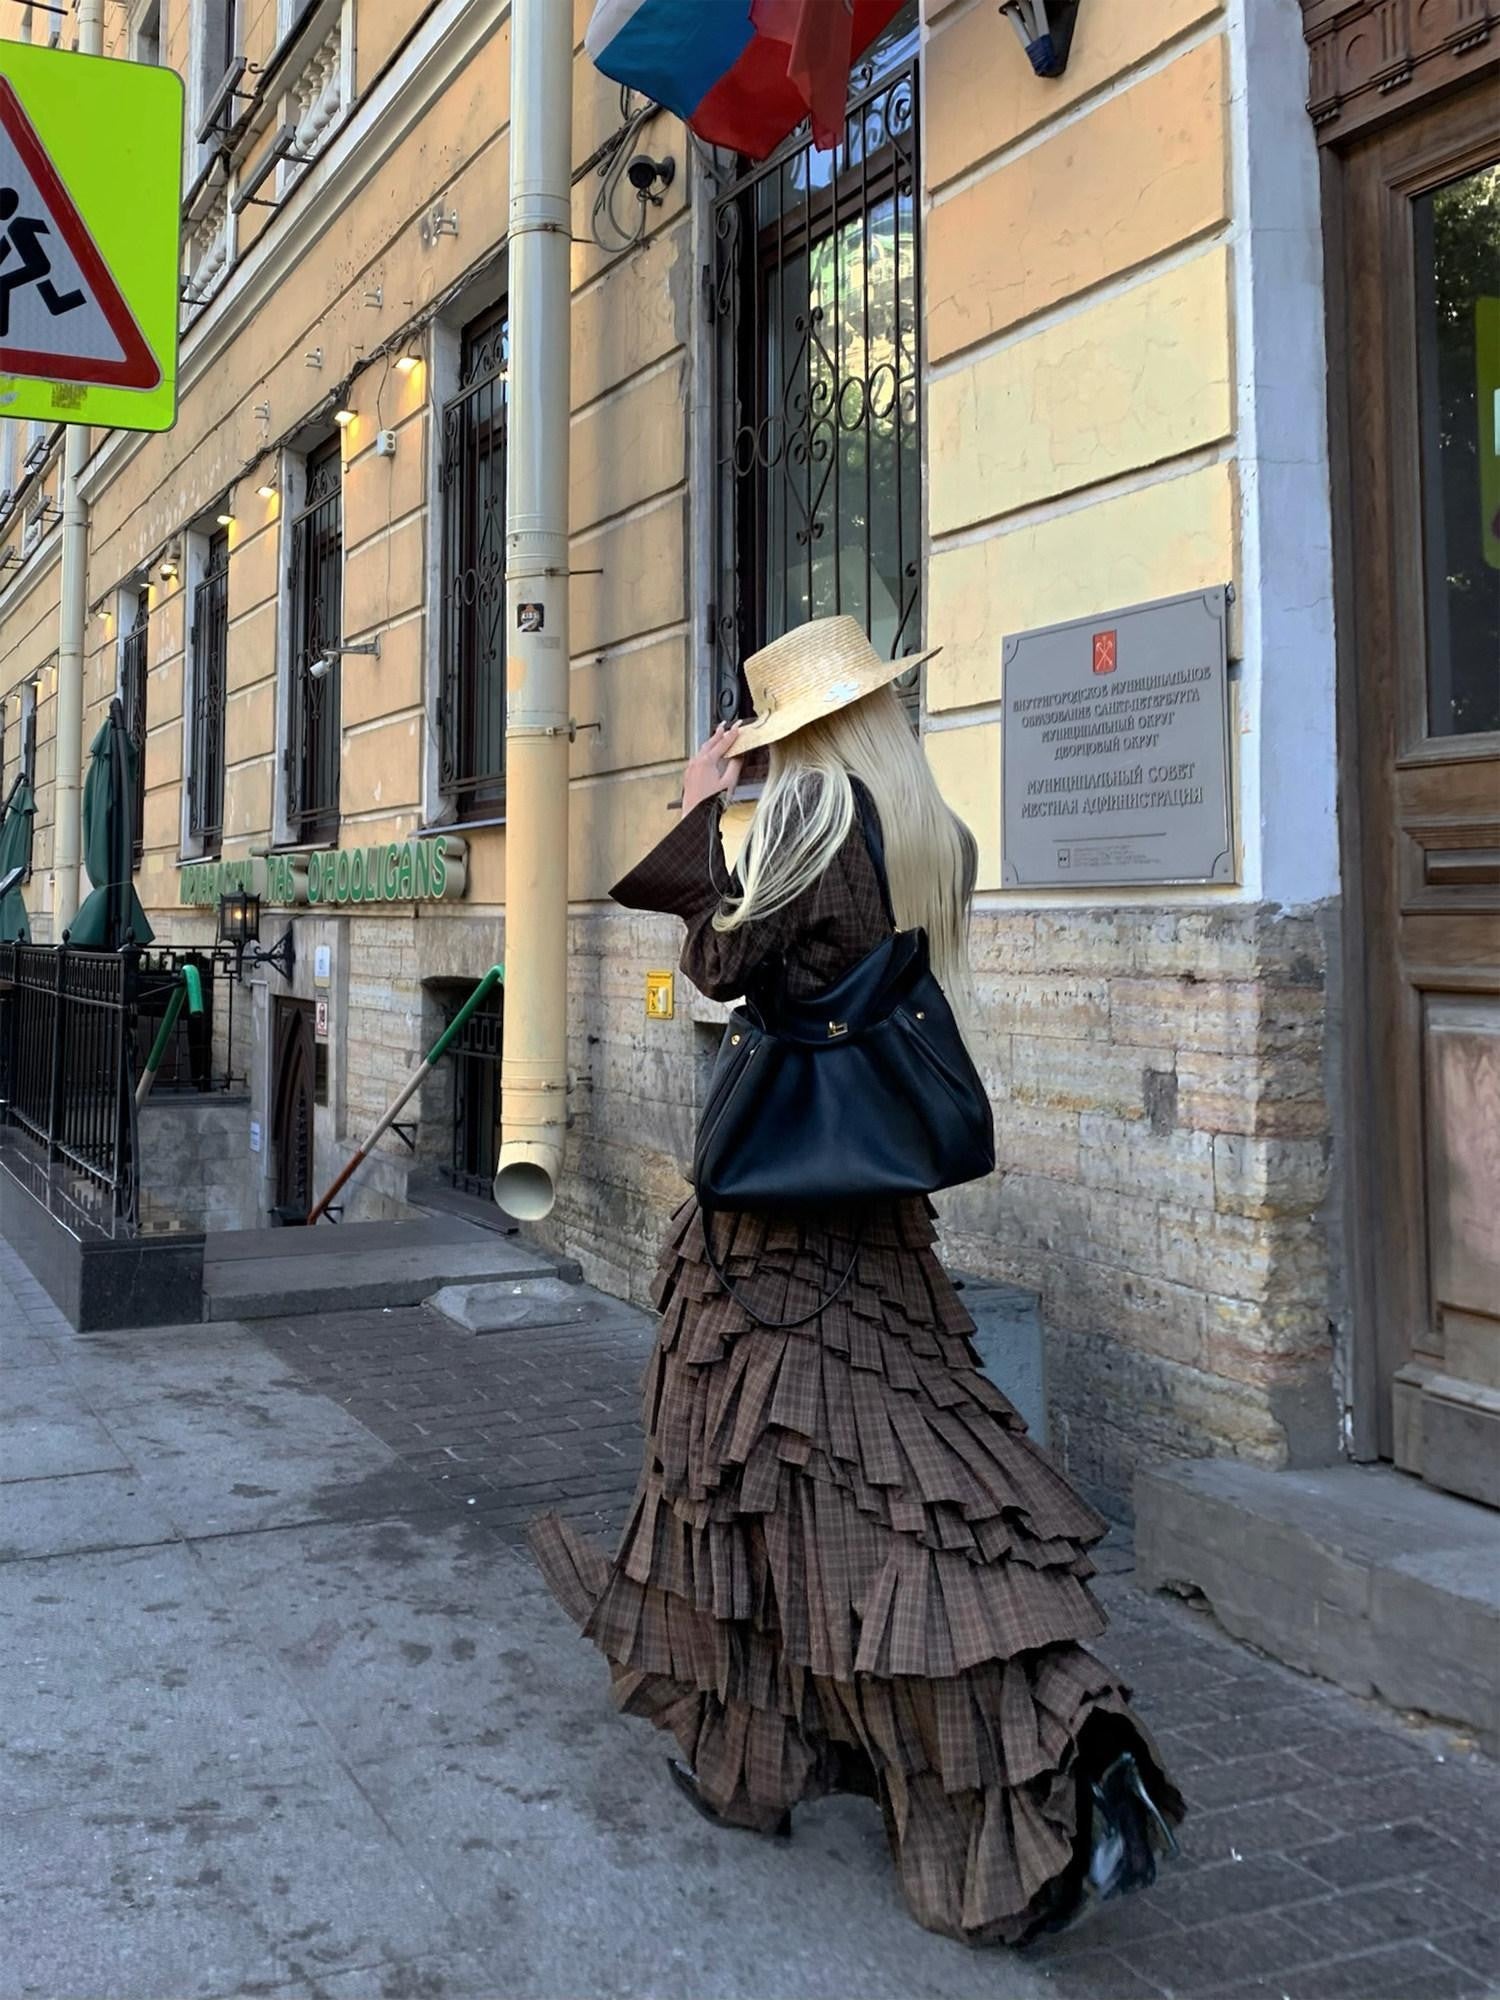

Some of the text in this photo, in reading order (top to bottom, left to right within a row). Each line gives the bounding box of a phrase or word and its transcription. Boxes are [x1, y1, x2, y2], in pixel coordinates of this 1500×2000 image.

[1013, 666, 1212, 713] ВНУТРИГОРОДСКОЕ МУНИЦИПАЛЬНОЕ
[1022, 687, 1201, 729] ОБРАЗОВАНИЕ САНКТ-ПЕТЕРБУРГА
[1041, 711, 1175, 743] МУНИЦИПАЛЬНЫЙ ОКРУГ
[1054, 733, 1160, 761] ДВОРЦОВЫЙ ОКРУГ
[1026, 762, 1196, 796] МУНИЦИПАЛЬНЫЙ СОВЕТ
[1021, 786, 1204, 819] МЕСТНАЯ АДМИНИСТРАЦИЯ
[266, 855, 297, 903] ПАБ
